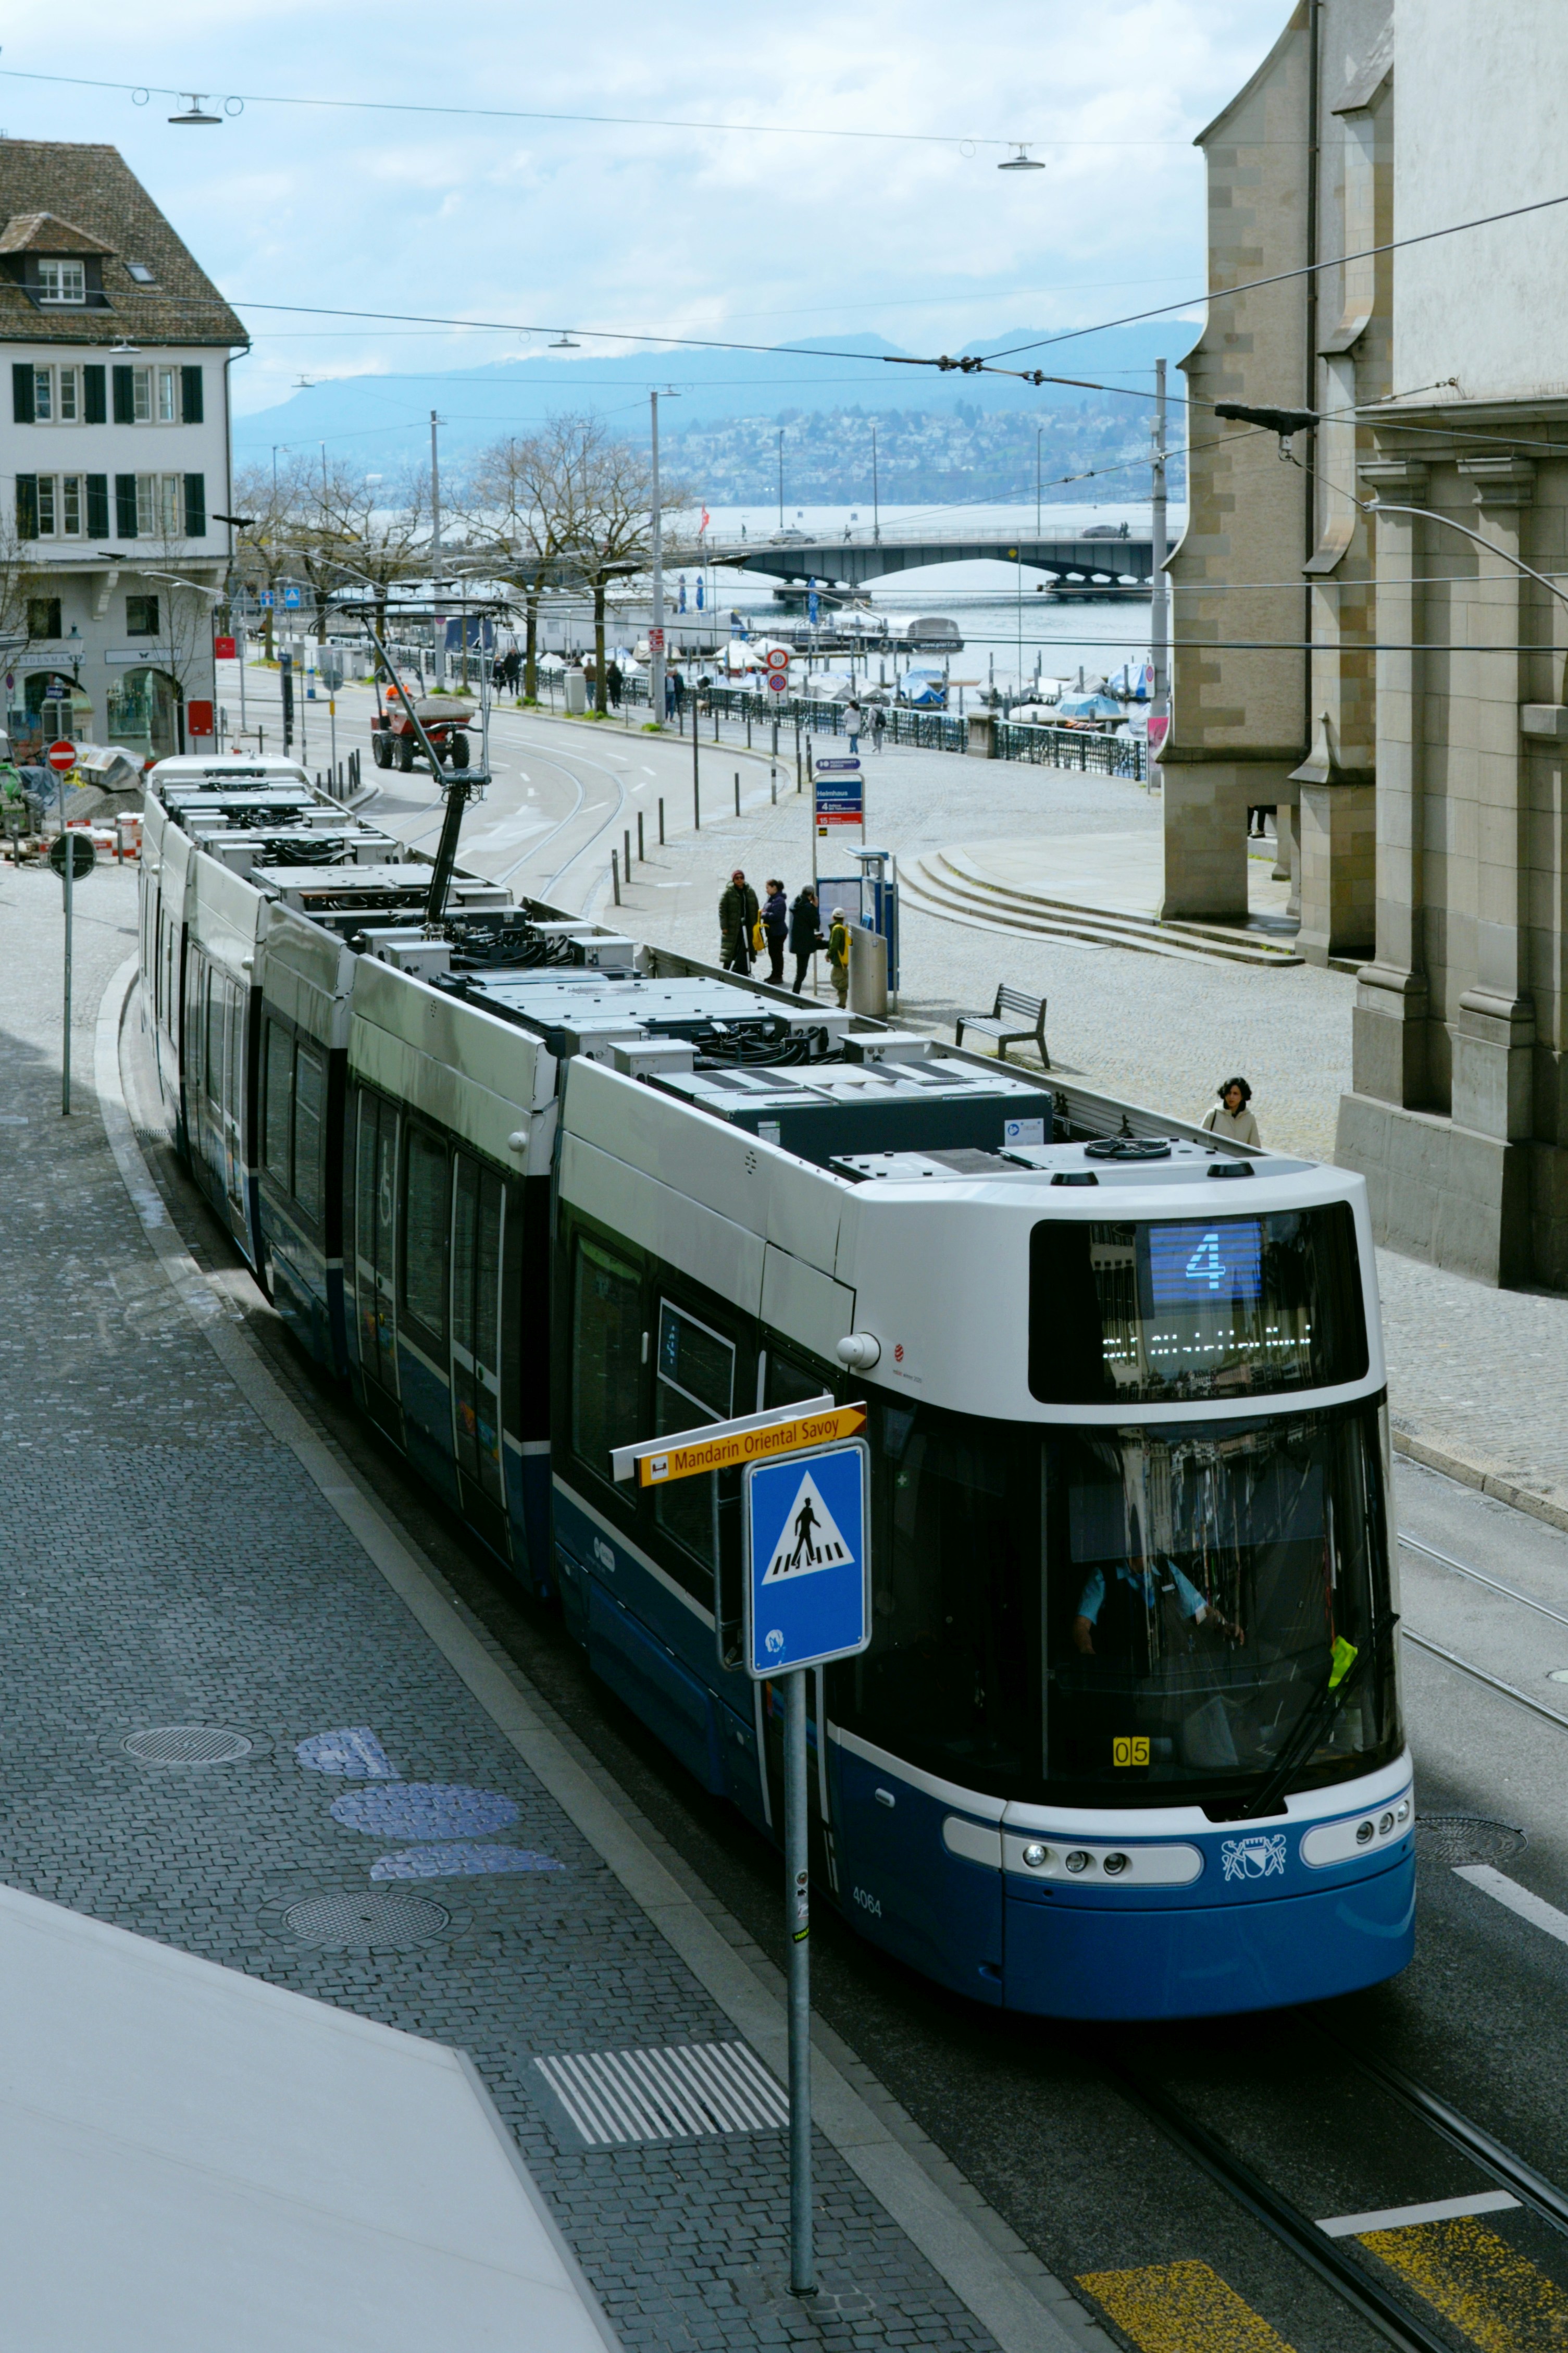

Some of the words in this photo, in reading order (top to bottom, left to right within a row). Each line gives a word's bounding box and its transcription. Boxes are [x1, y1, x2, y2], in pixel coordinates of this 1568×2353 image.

[822, 802, 828, 811] 4
[1186, 1234, 1225, 1289] 4
[675, 1440, 739, 1471] Mandarin
[744, 1423, 797, 1453] Oriental
[801, 1419, 839, 1440] Savoy
[1115, 1742, 1148, 1763] 05
[853, 1886, 882, 1918] 4064
